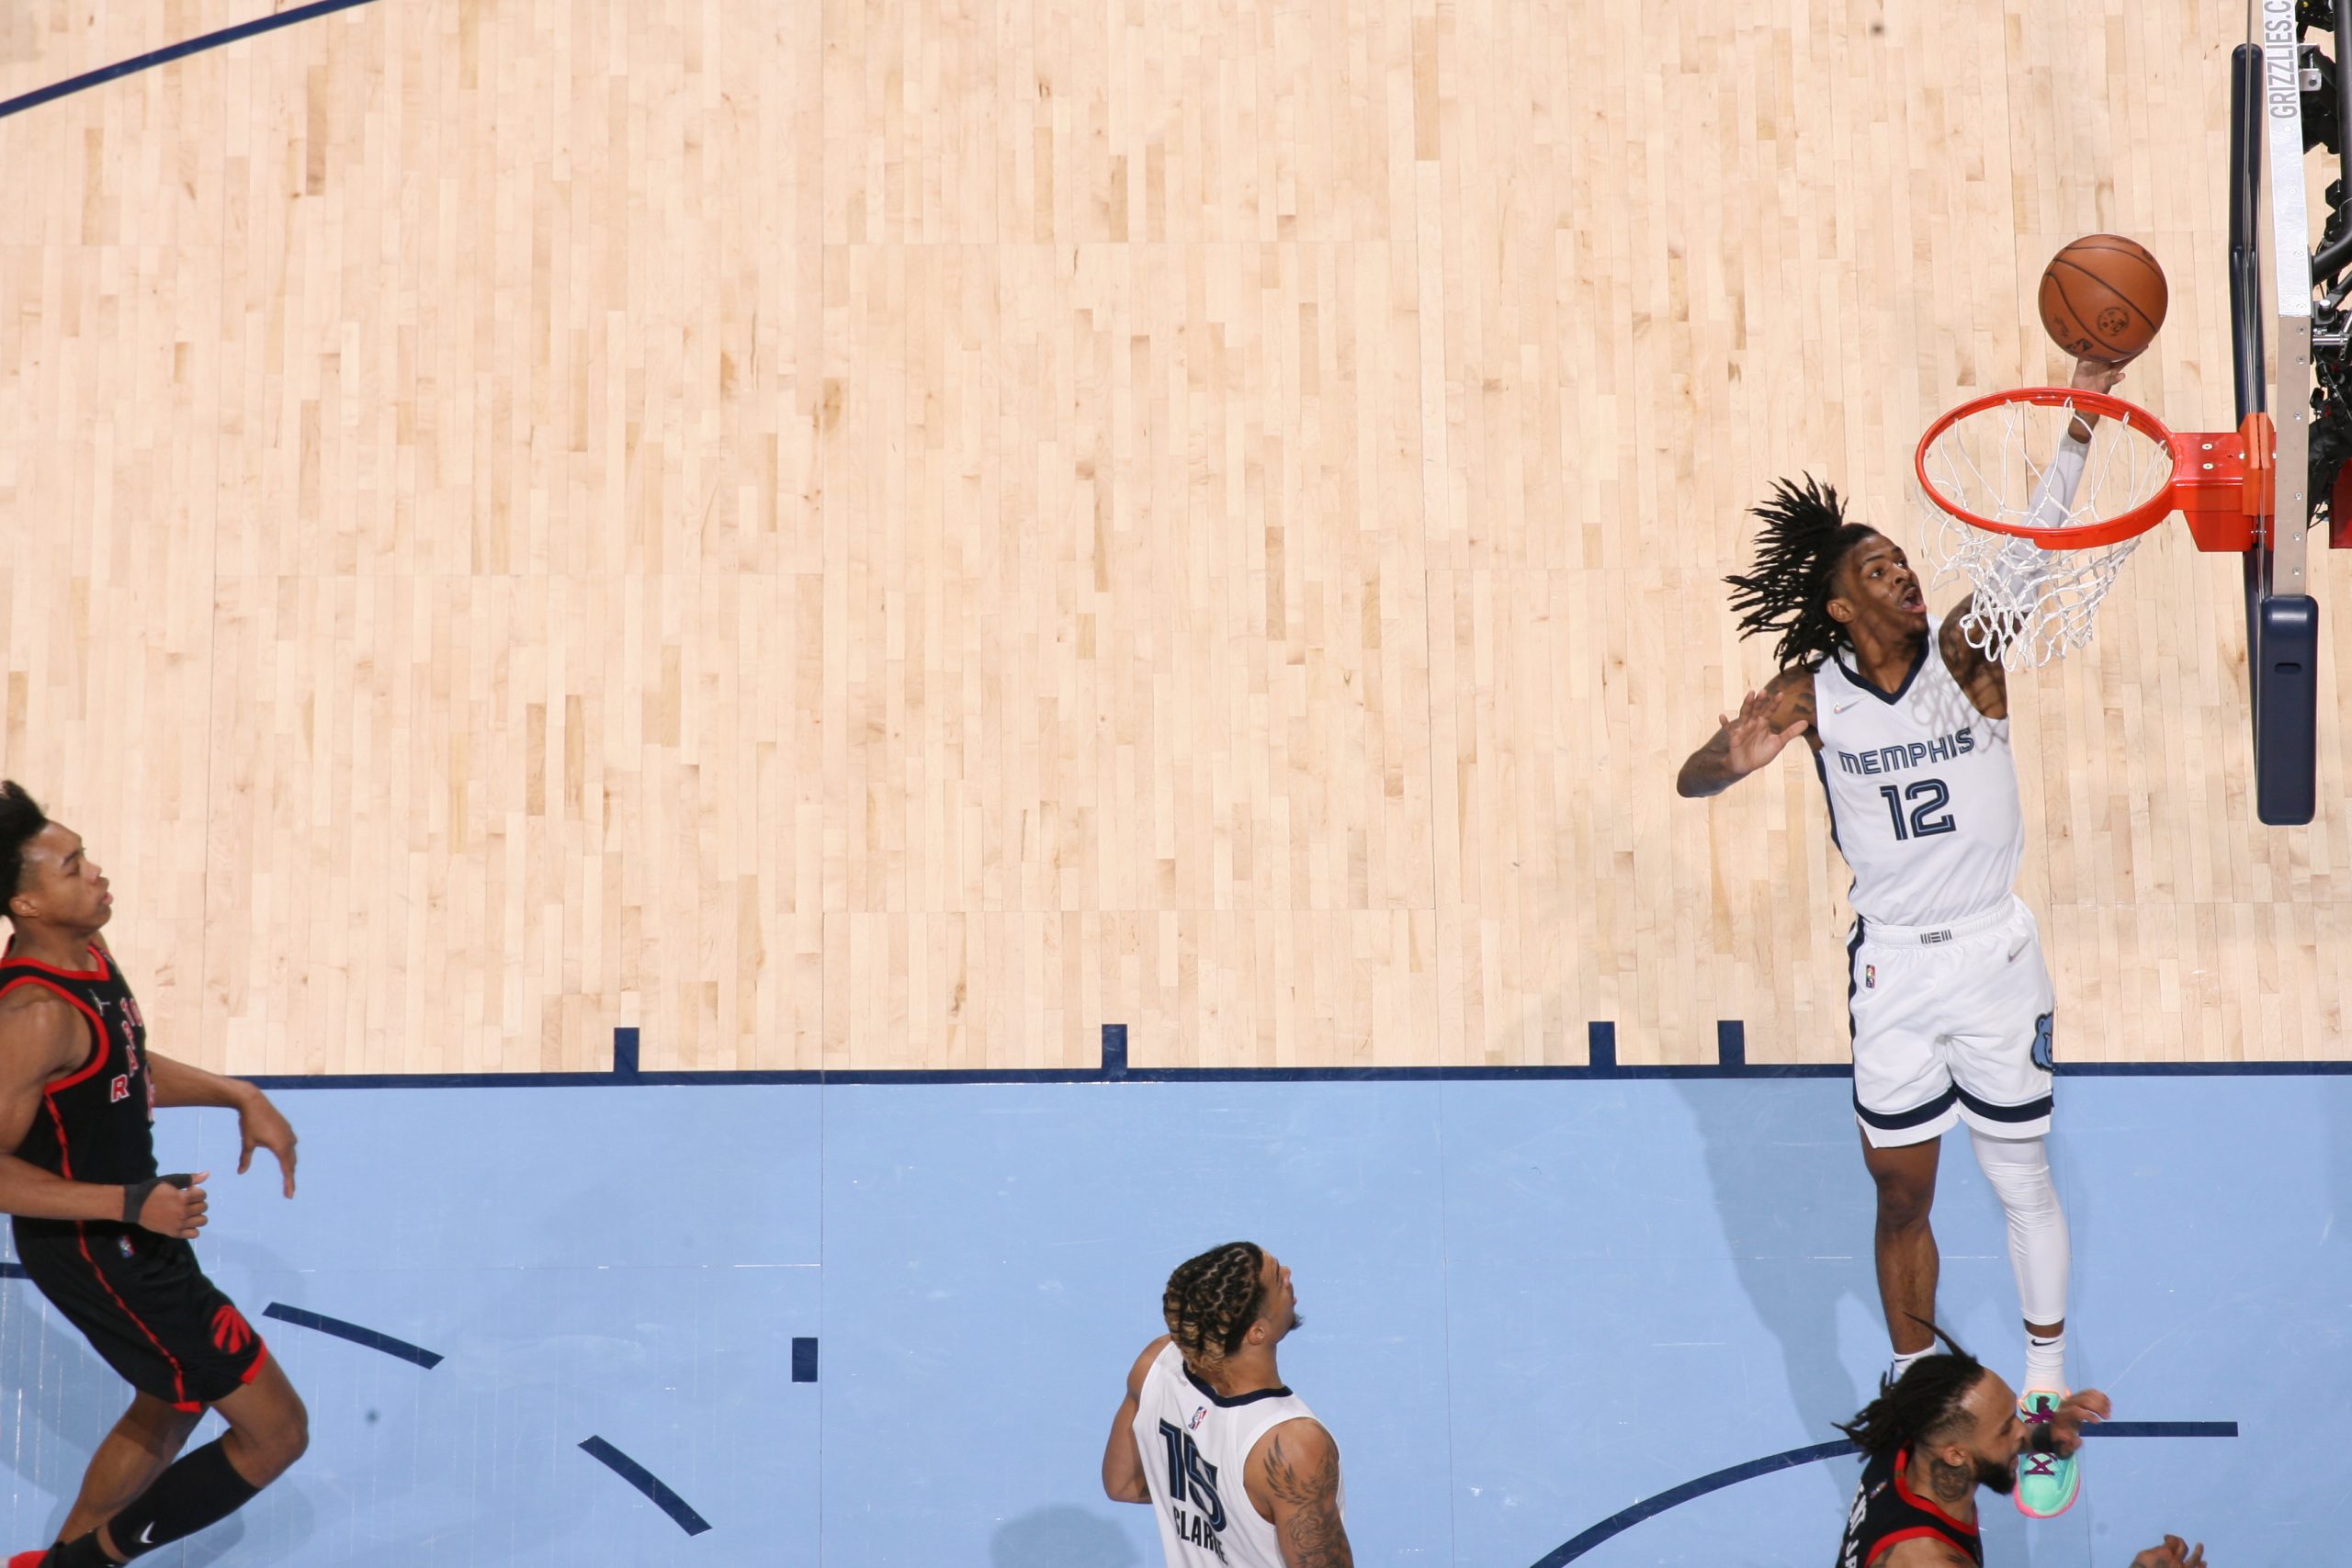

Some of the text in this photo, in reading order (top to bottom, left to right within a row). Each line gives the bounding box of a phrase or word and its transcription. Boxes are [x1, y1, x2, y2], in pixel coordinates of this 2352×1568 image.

[1838, 727, 1975, 775] MEMPHIS
[1880, 778, 1957, 840] 12
[1159, 1417, 1227, 1532] 15
